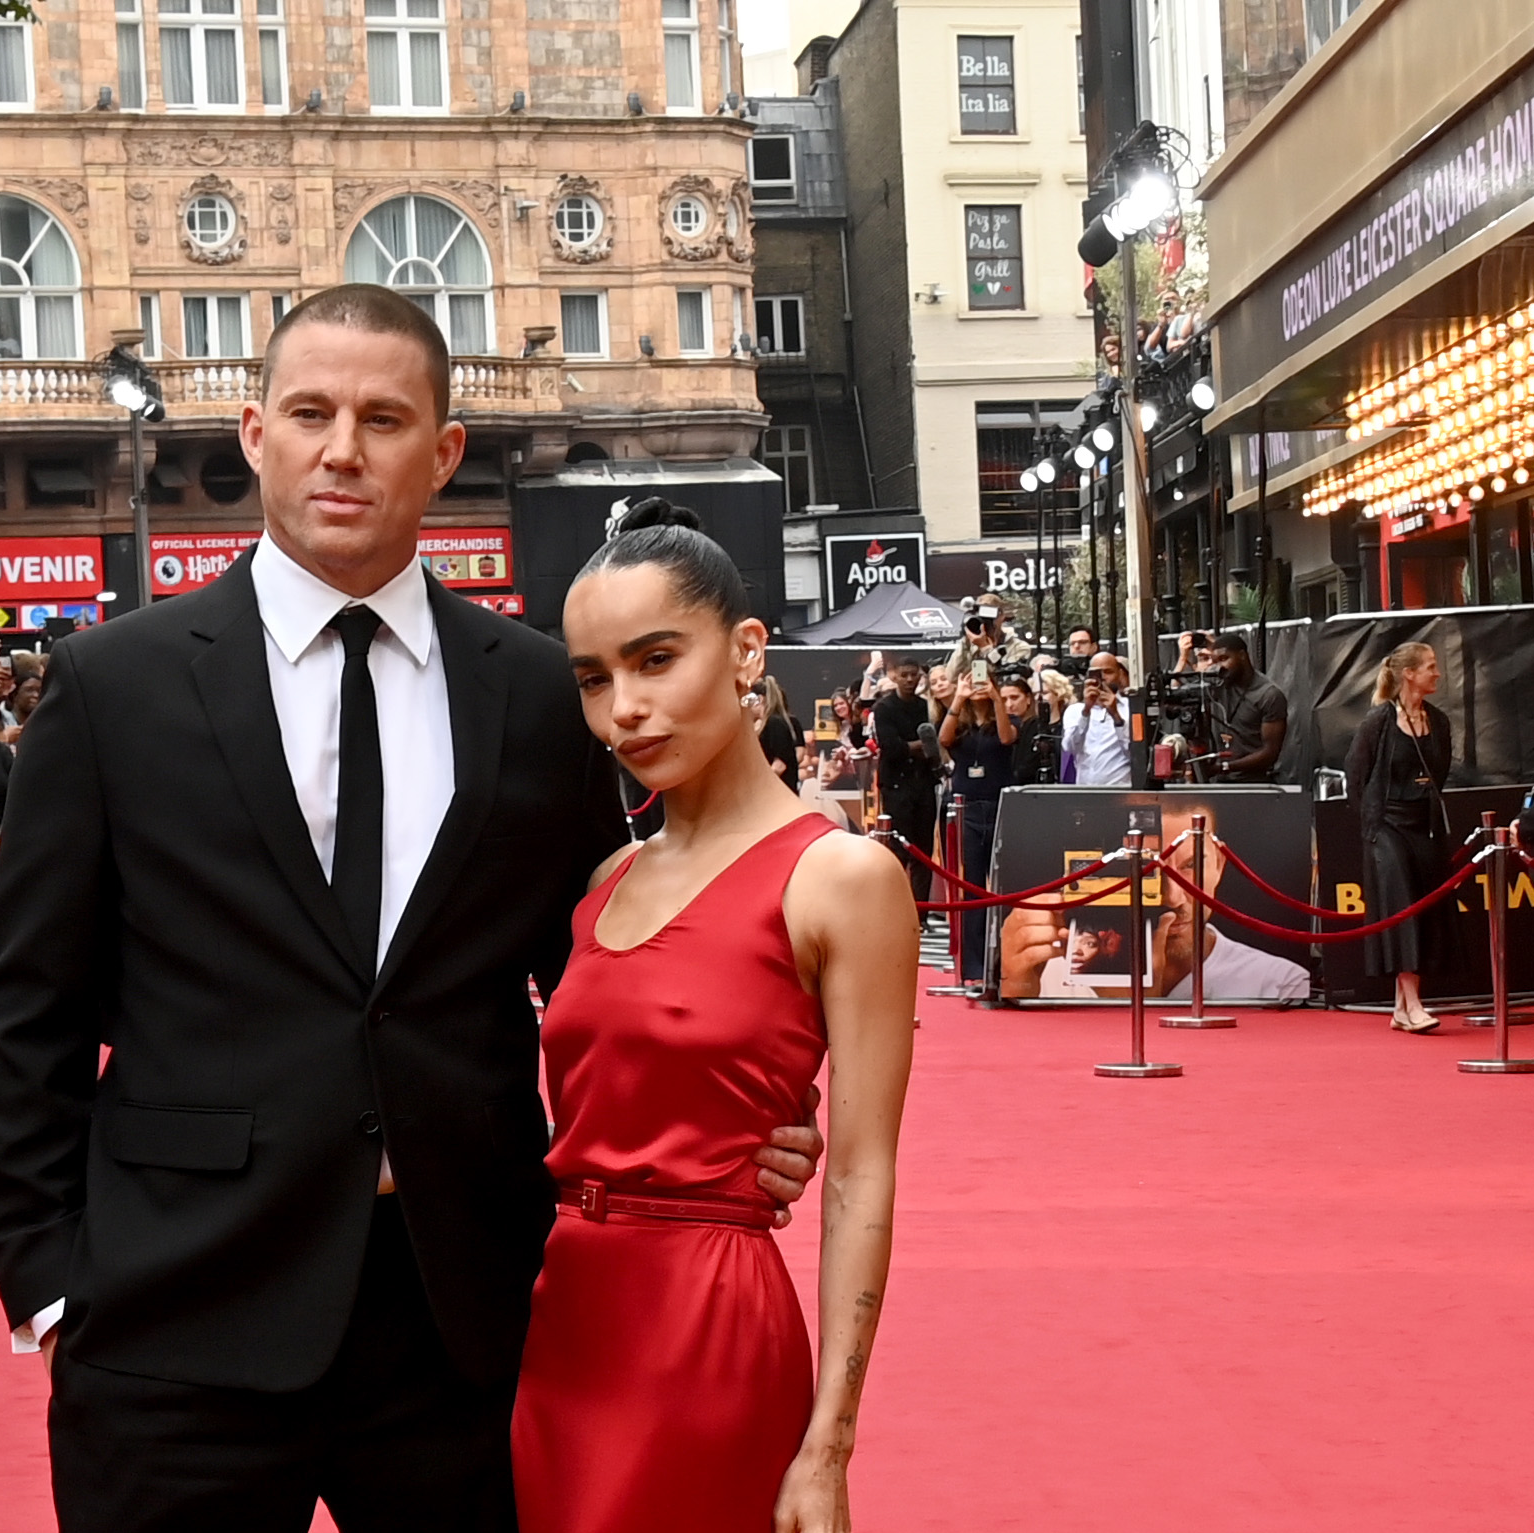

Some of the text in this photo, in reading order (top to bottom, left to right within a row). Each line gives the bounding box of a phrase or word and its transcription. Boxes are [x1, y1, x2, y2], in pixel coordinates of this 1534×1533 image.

[960, 55, 1010, 76] Bella
[968, 210, 1010, 232] Pizza
[1282, 265, 1321, 342] ODEON
[1321, 239, 1353, 314] LUXE
[1353, 188, 1423, 292] LEICESTER
[1423, 136, 1488, 242] SQUARE
[152, 539, 195, 550] OFFICIAL
[847, 562, 907, 590] Apna
[985, 558, 1063, 592] Bella
